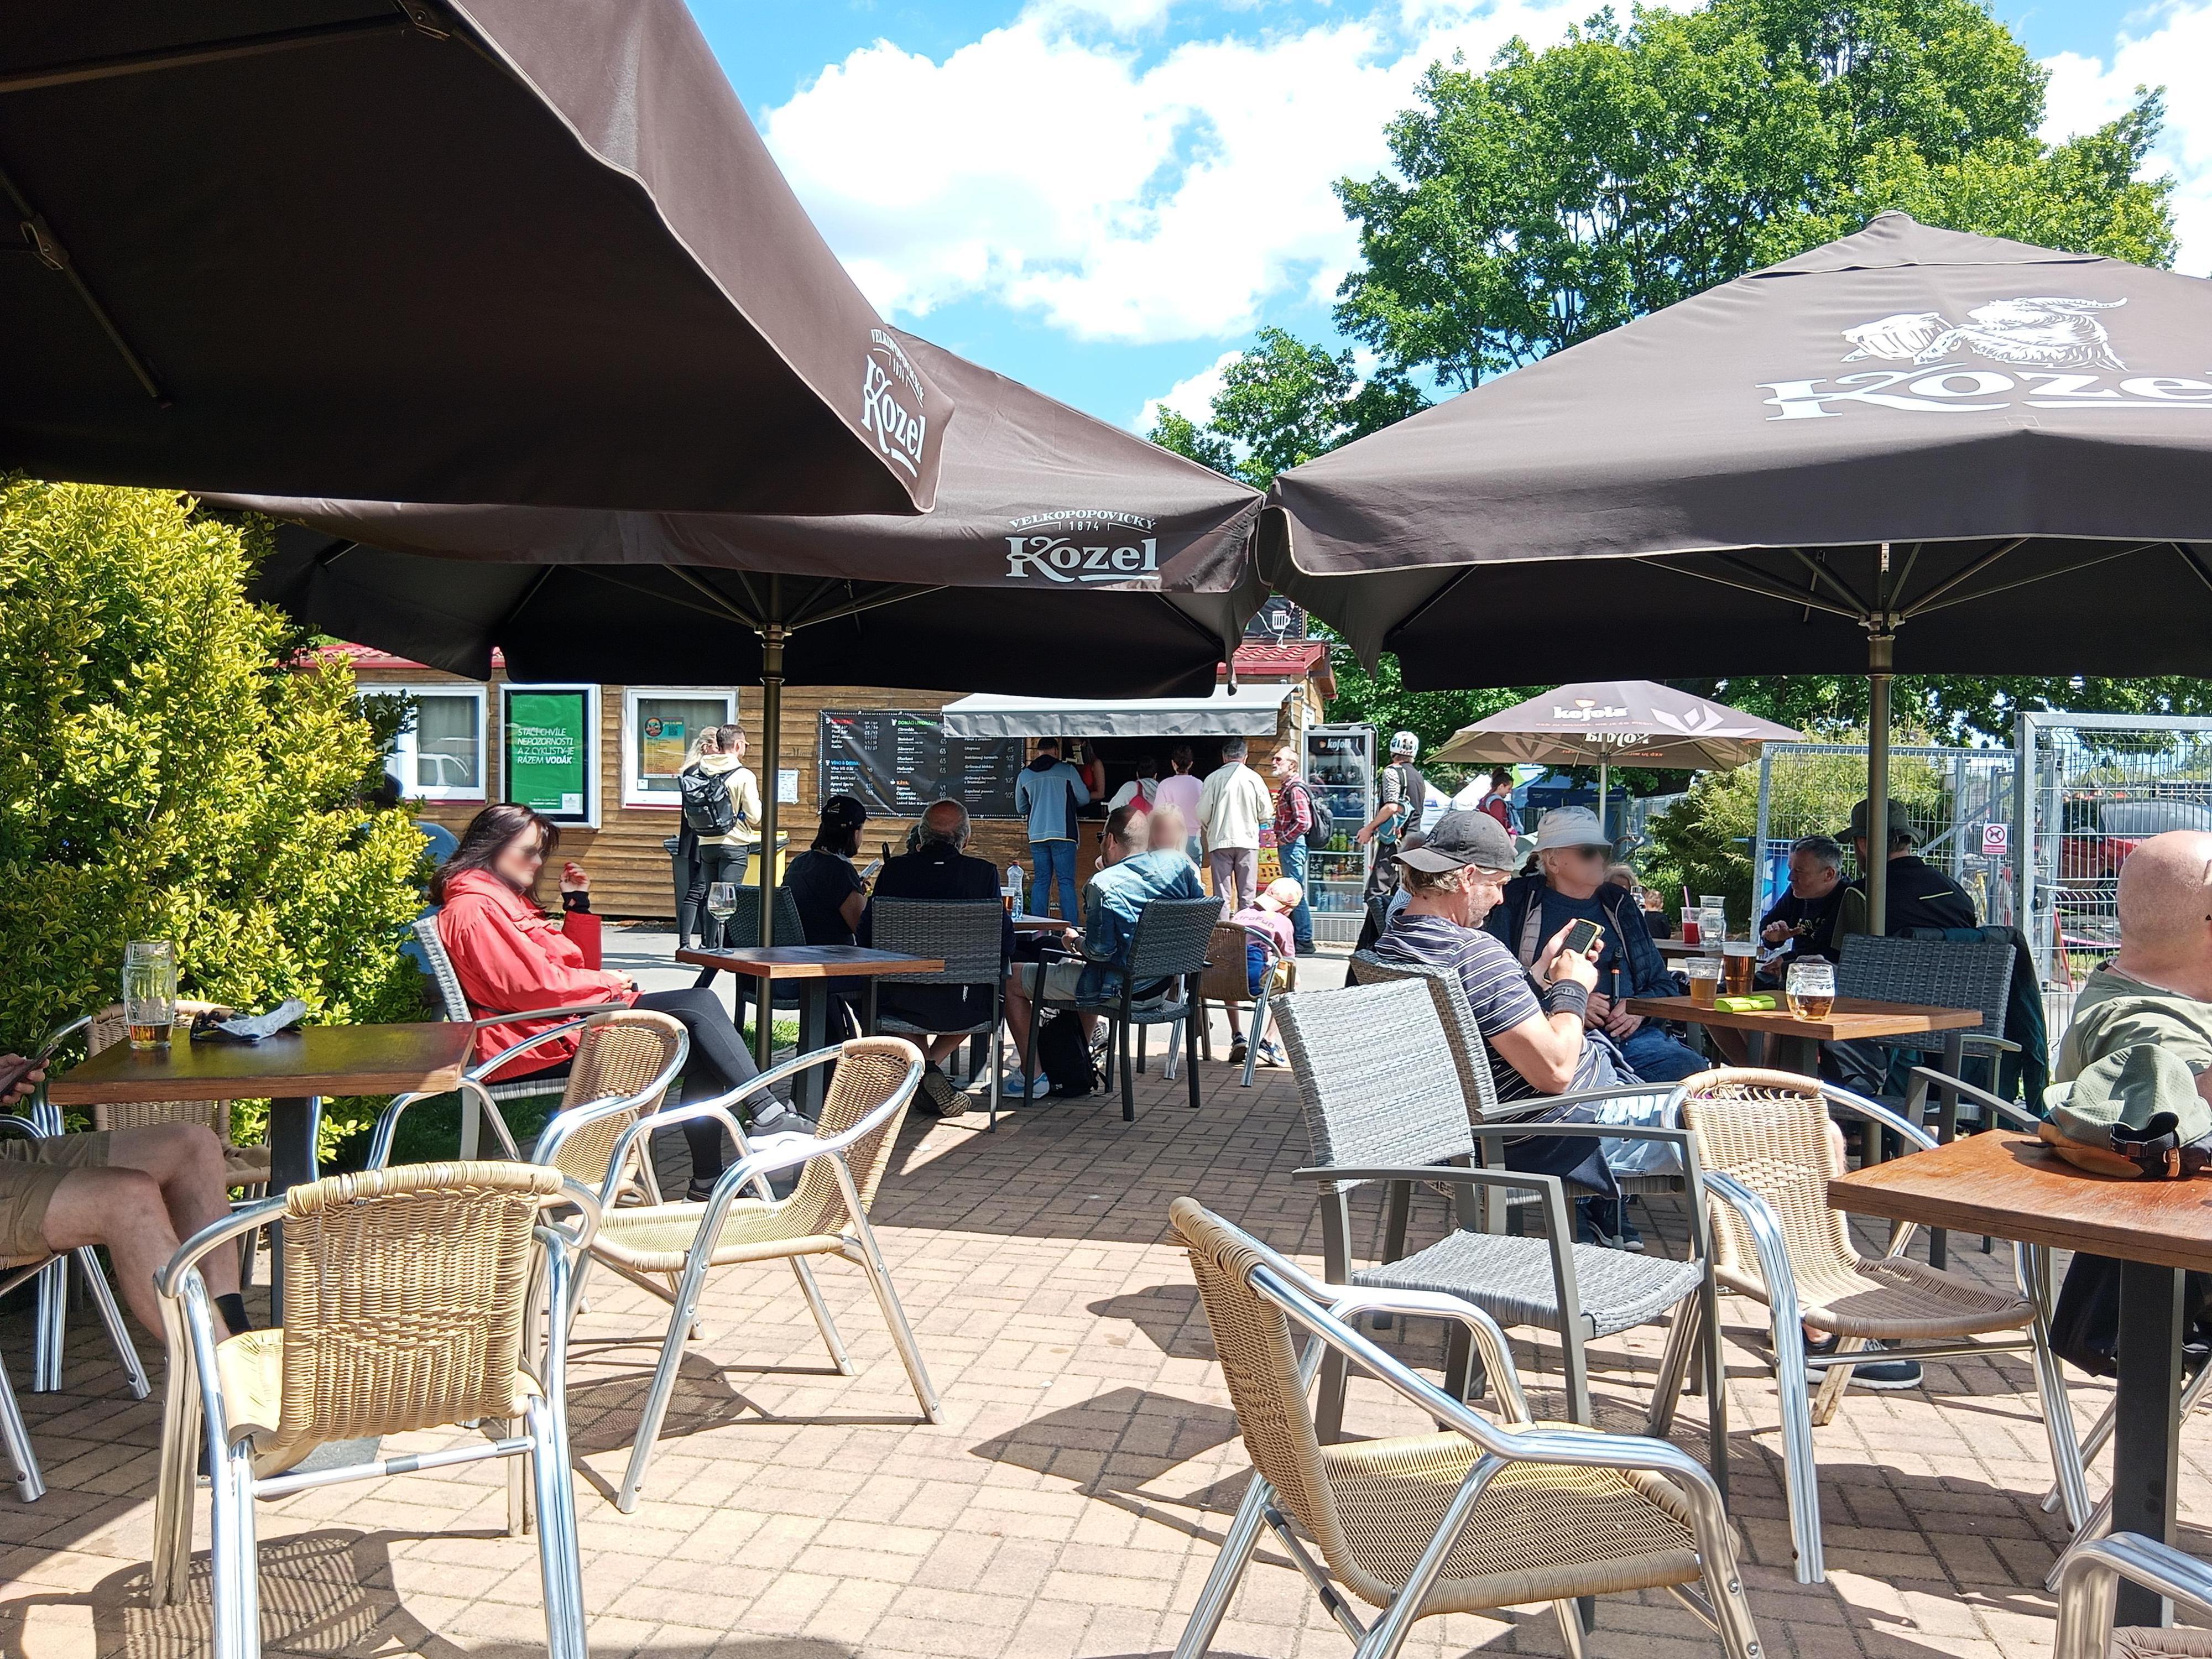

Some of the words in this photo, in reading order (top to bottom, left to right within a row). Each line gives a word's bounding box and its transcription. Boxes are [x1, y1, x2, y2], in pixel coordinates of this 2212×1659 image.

[1755, 363, 2212, 421] Koze
[861, 354, 926, 465] Kozel
[1009, 510, 1157, 530] VELKOPOPOVICKÝ
[1070, 521, 1099, 531] 1874
[1005, 536, 1159, 583] Kozel
[1553, 706, 1628, 721] kofola
[518, 727, 539, 736] STAČÍ
[540, 727, 567, 735] CHVÍLE
[518, 737, 573, 745] NEPOZORNOSTI
[567, 747, 575, 755] JE
[518, 755, 544, 764] RÁZEM
[545, 755, 572, 764] VODÁK
[1235, 915, 1275, 929] traFun
